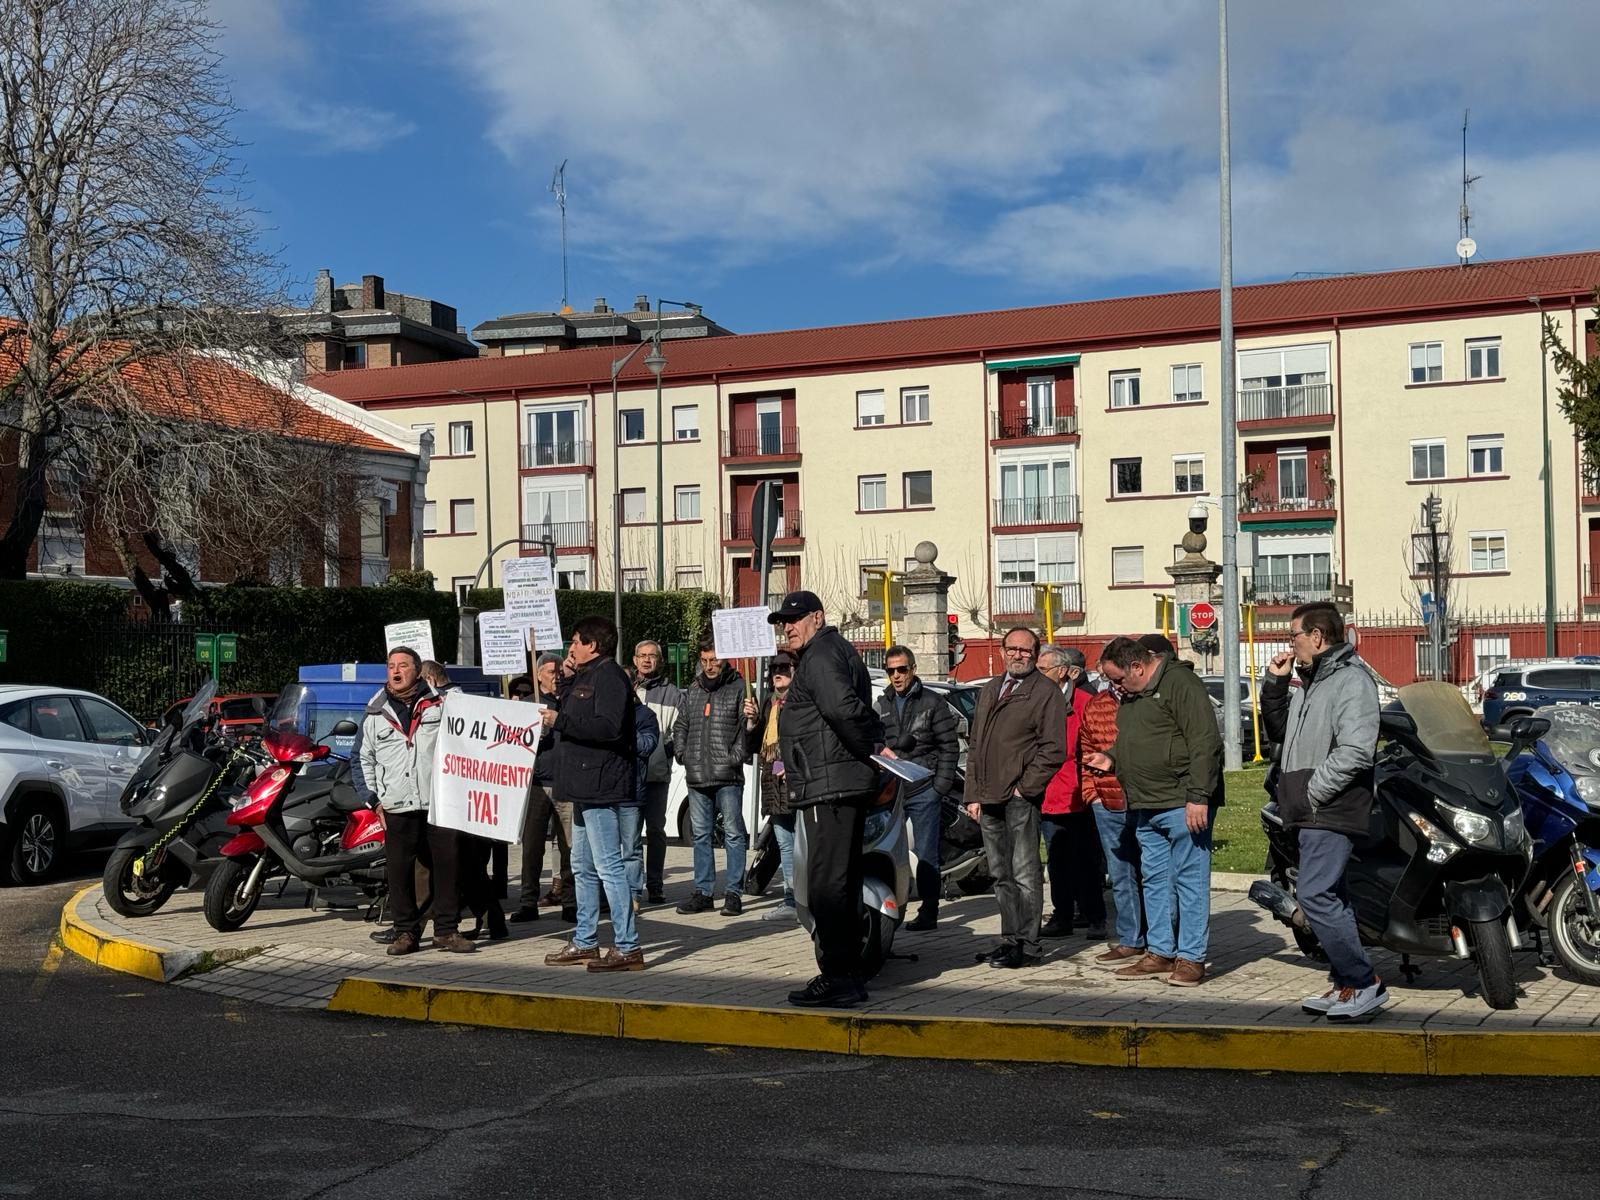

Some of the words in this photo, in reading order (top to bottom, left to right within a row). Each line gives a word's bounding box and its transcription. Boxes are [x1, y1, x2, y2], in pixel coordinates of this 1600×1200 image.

[224, 651, 233, 659] 07
[447, 716, 465, 736] NO
[469, 720, 488, 741] AL
[493, 723, 535, 747] MURO
[442, 753, 533, 788] SOTERRAMIENTO
[468, 790, 499, 826] ¡YA!
